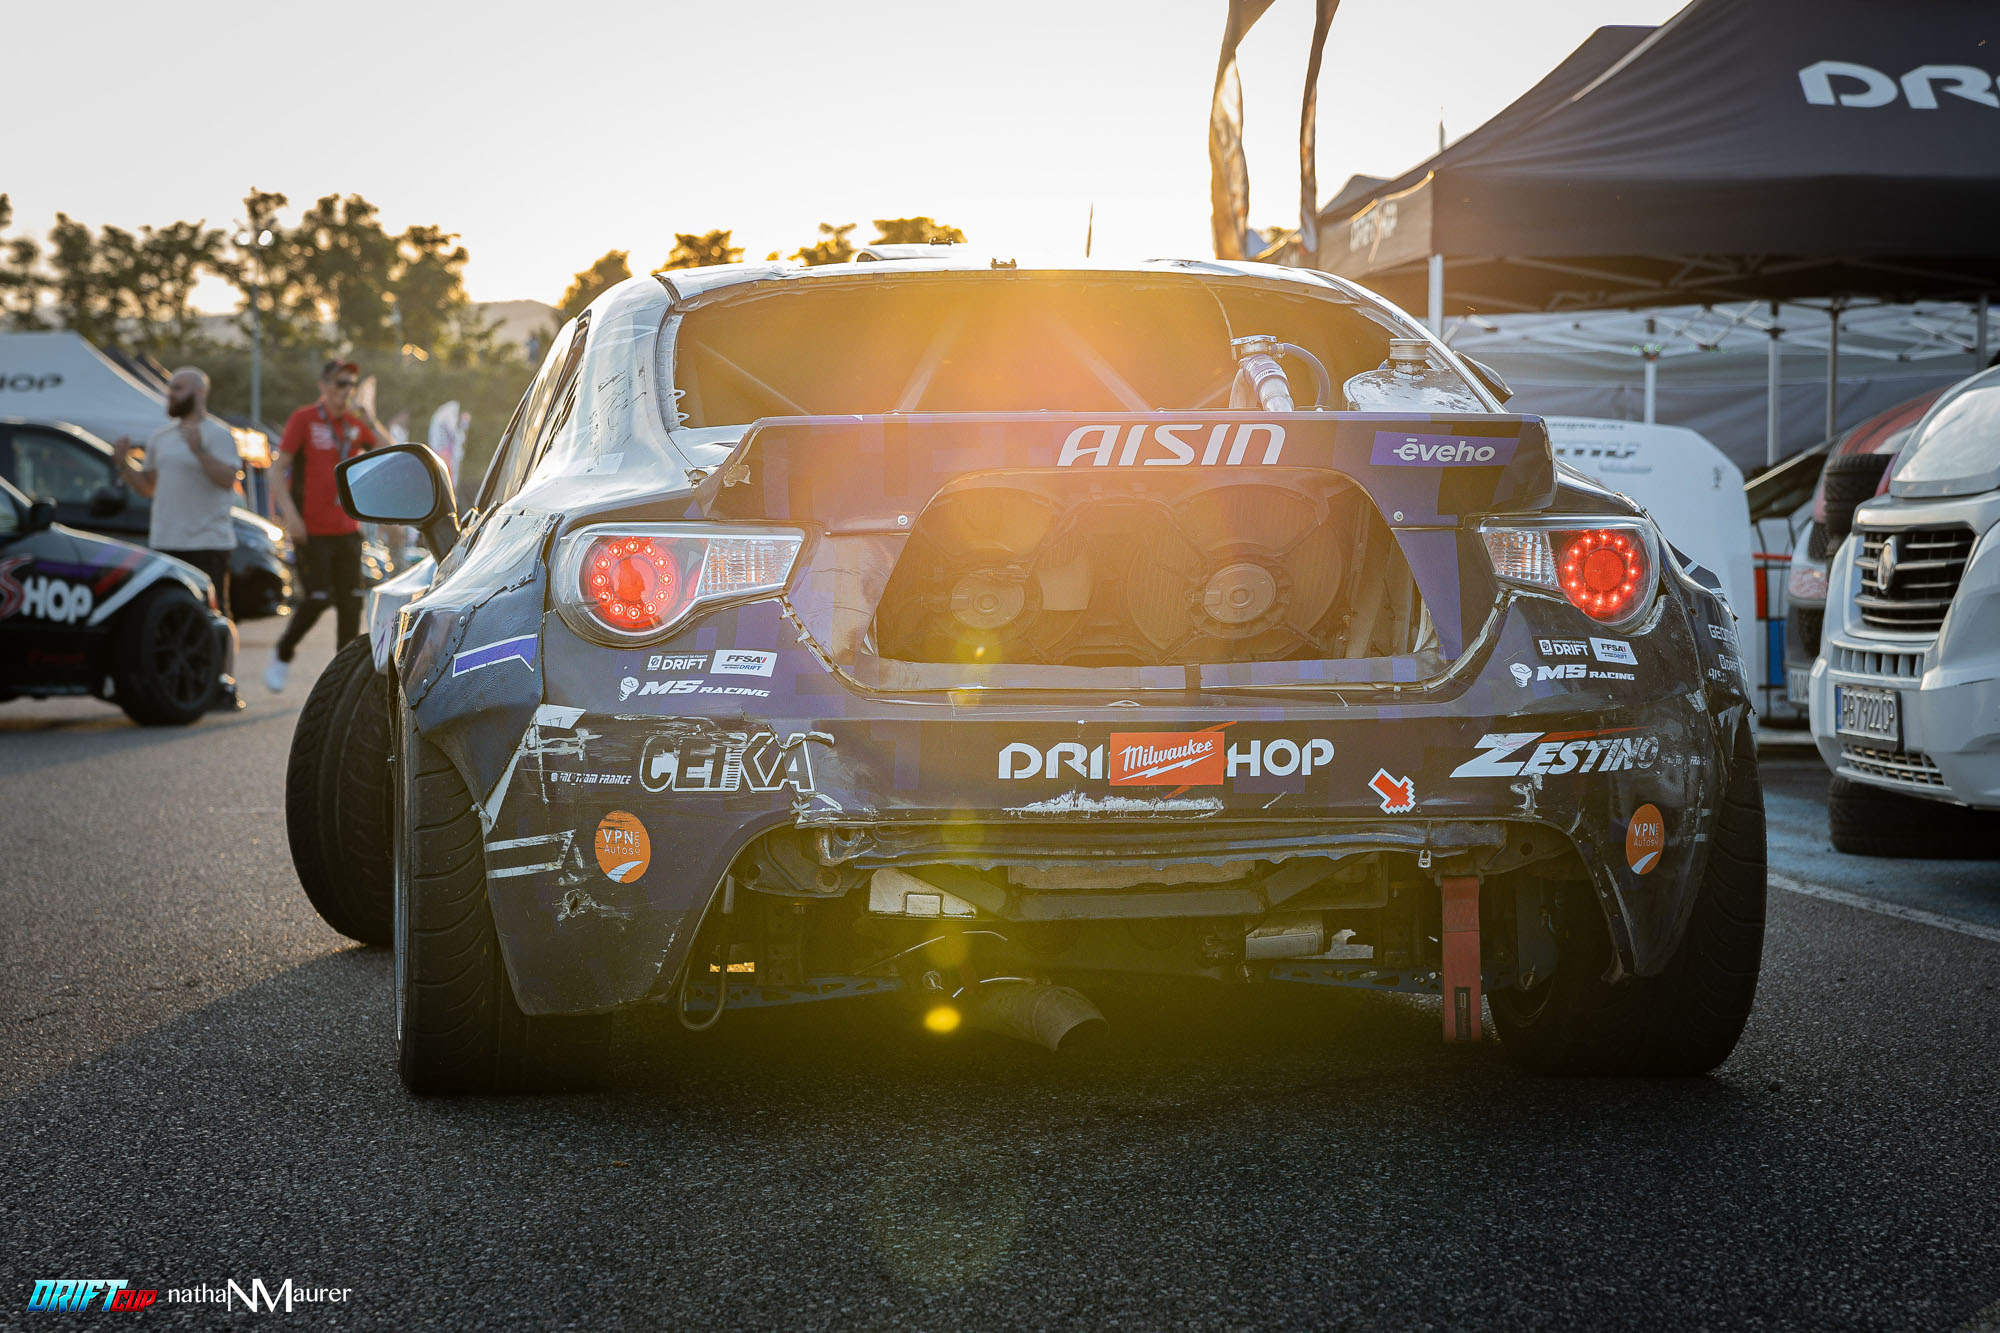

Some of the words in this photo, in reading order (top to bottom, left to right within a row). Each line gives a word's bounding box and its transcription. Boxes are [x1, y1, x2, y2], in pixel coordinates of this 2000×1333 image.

[1798, 60, 2000, 109] DR
[1057, 424, 1286, 466] AISIN
[1552, 643, 1588, 656] DRIFT
[1601, 643, 1625, 653] FFSA
[661, 658, 708, 671] DRIFT
[726, 654, 763, 664] FFSA
[1589, 671, 1635, 681] RACING
[699, 686, 771, 698] RACING
[998, 742, 1110, 779] DRI
[1118, 738, 1214, 772] Milwaukee
[1227, 738, 1335, 777] HOP
[1449, 731, 1659, 778] ZESTINO
[599, 774, 632, 785] FRANCE
[602, 828, 634, 845] VPN
[1634, 823, 1656, 837] VPN
[1633, 836, 1654, 847] Autos
[604, 844, 634, 856] Autos
